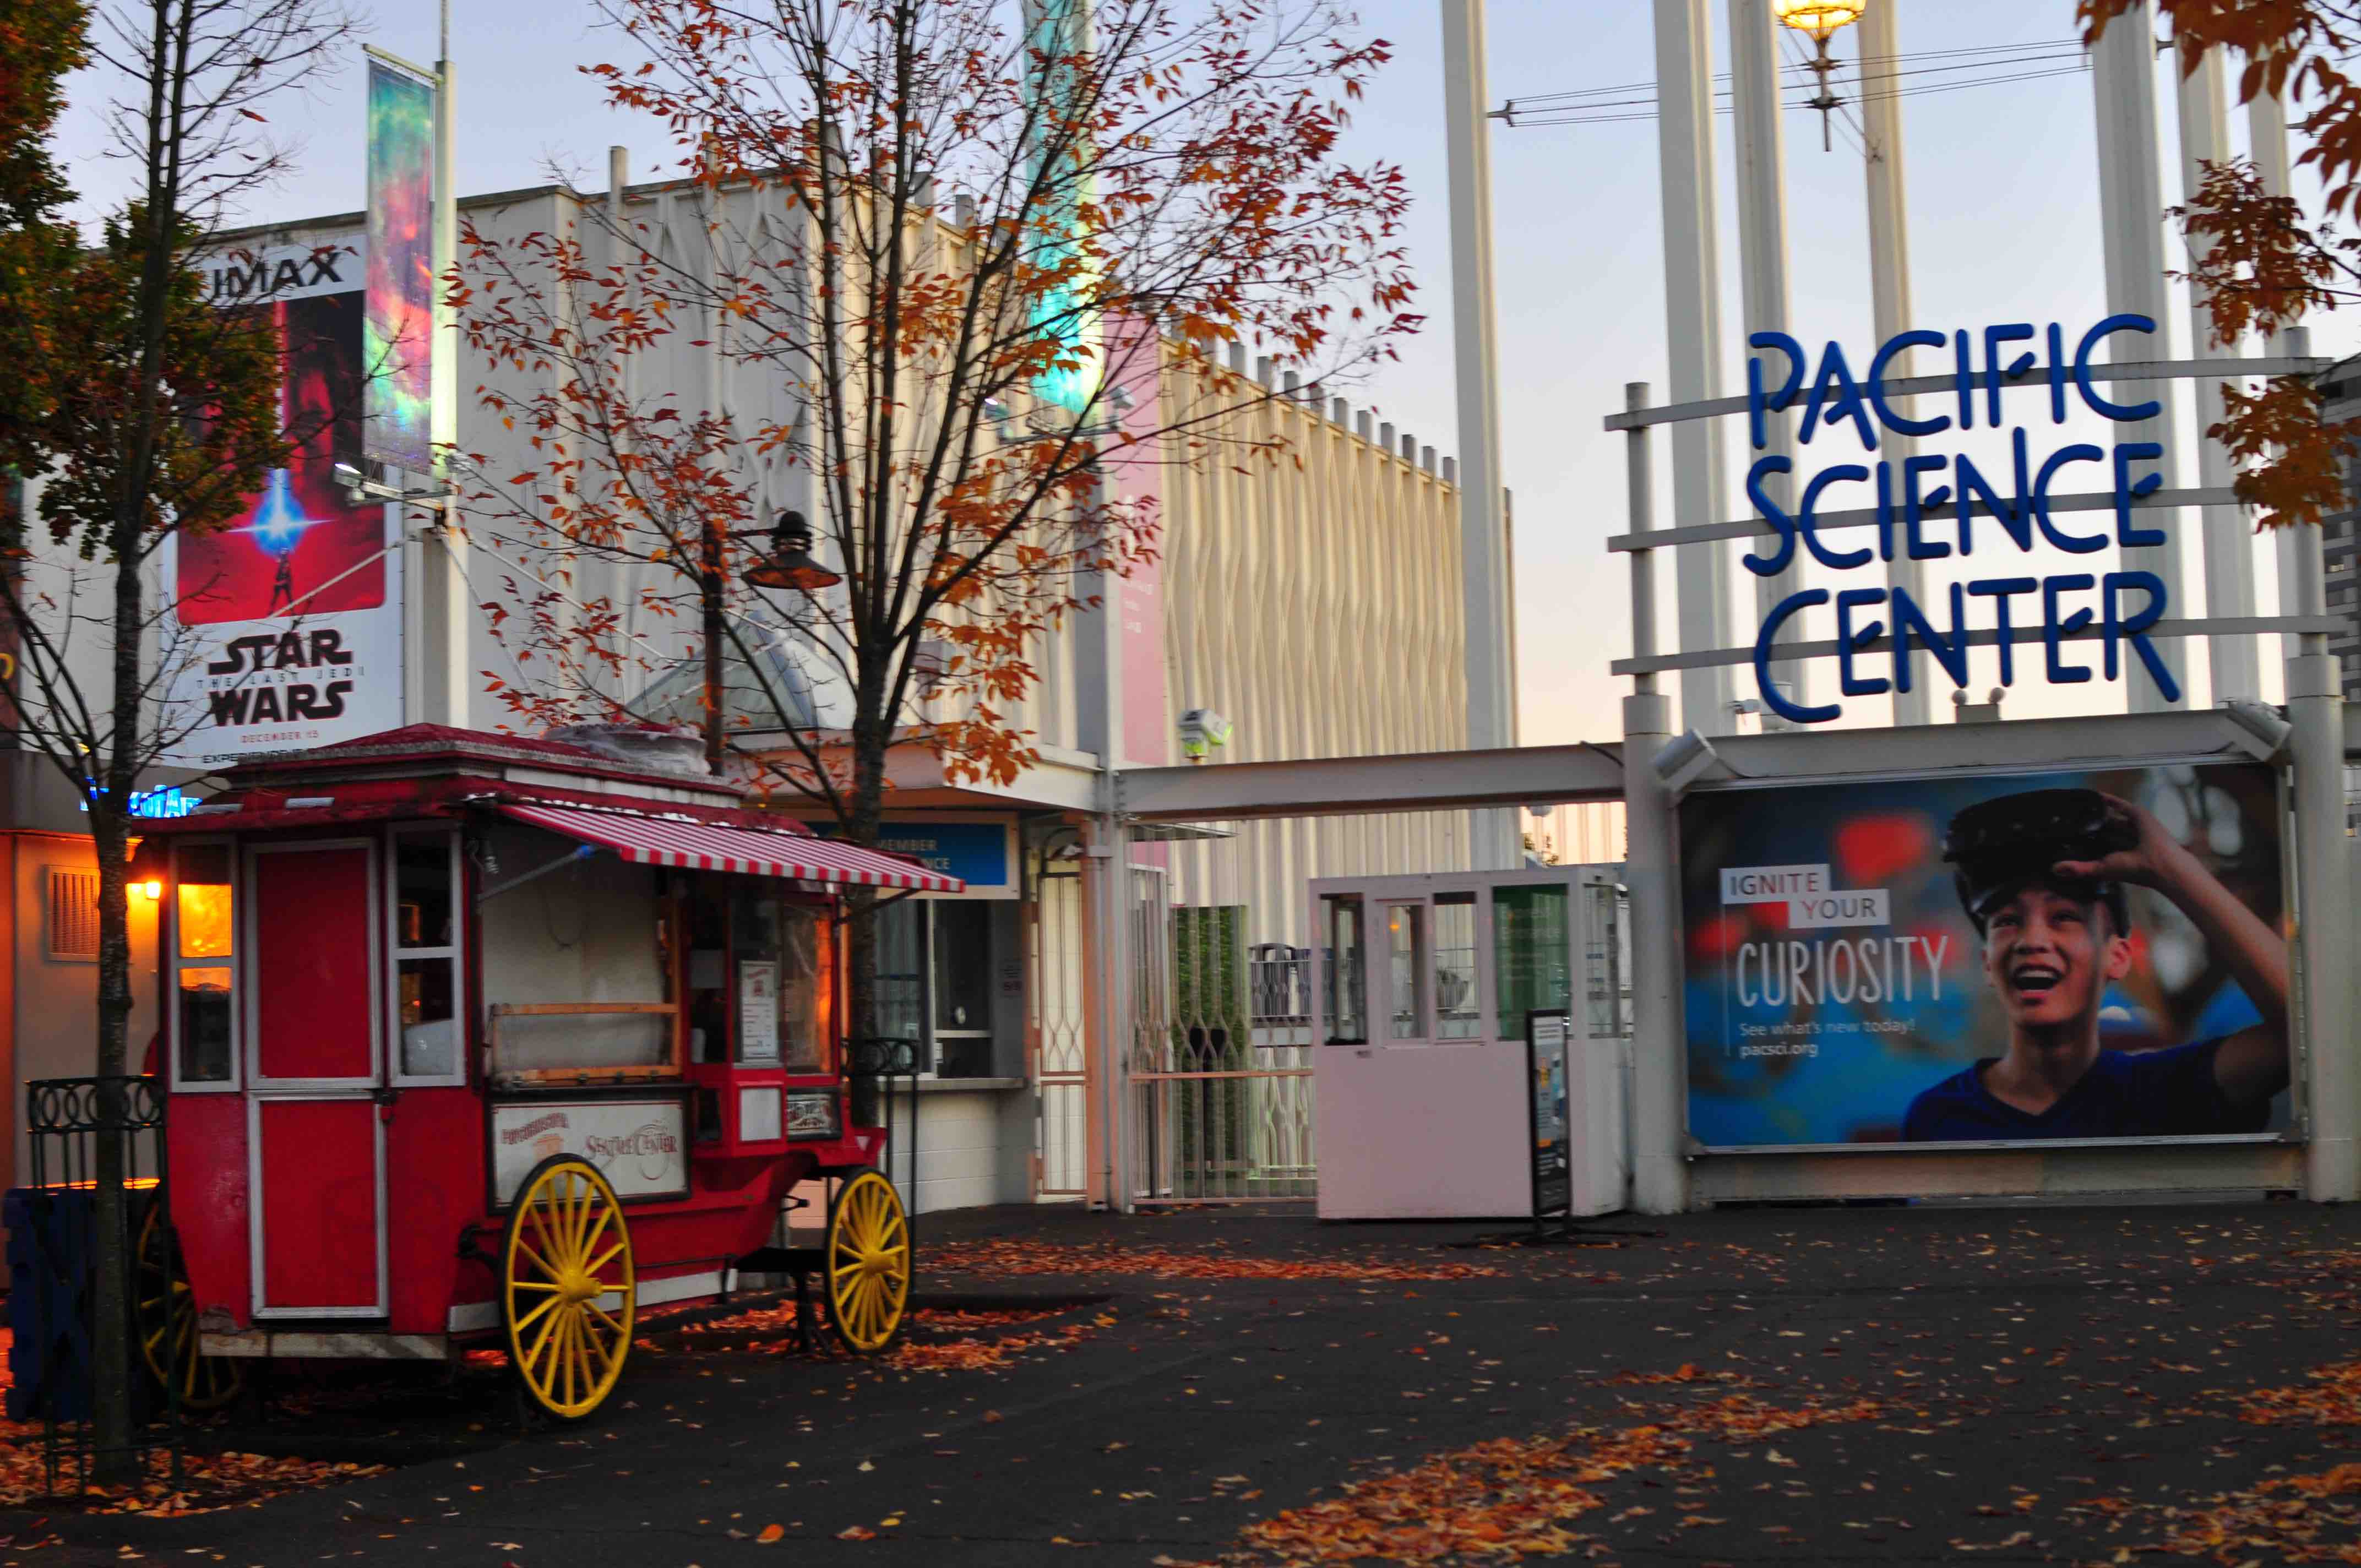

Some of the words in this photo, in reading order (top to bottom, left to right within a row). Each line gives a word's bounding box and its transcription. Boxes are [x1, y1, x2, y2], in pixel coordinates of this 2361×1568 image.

[214, 251, 344, 298] IMAX
[1748, 313, 2161, 451] PACIFIC
[1743, 426, 2166, 577] SCIENCE
[208, 628, 353, 676] STAR
[1753, 570, 2180, 723] CENTER
[196, 677, 233, 689] THE
[249, 672, 300, 685] LAST
[316, 665, 365, 679] JEDI
[208, 679, 353, 727] WARS
[241, 731, 301, 743] DECEMBER
[1730, 872, 1820, 896] IGNITE
[1800, 897, 1877, 920] YOUR
[1736, 935, 1949, 1008] CURIOSITY
[1739, 1022, 1767, 1036] See
[1770, 1021, 1822, 1035] what's
[1825, 1022, 1859, 1033] new
[1862, 1018, 1916, 1035] today!
[1739, 1041, 1819, 1059] pacsci.org
